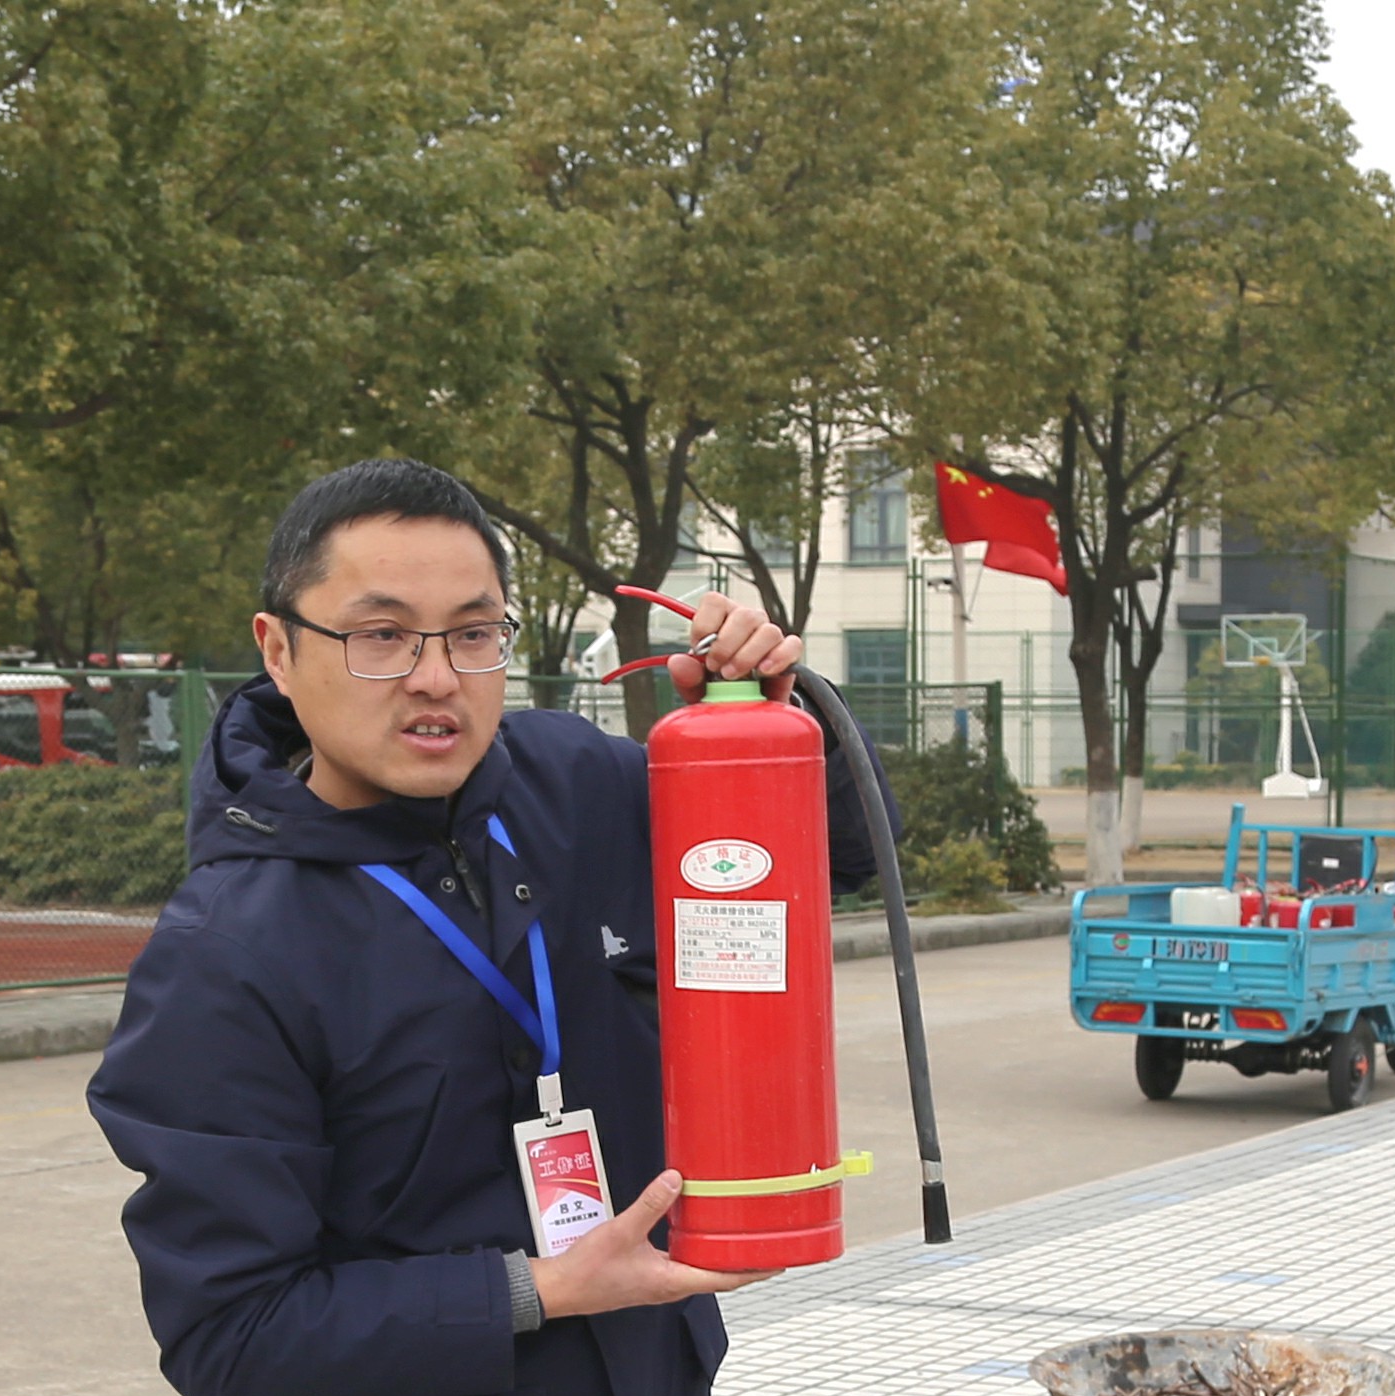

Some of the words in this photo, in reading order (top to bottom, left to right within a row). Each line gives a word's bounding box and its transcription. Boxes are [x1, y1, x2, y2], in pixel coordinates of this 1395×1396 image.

[696, 846, 753, 865] 合格证
[693, 905, 765, 916] 灭火器维修合格证
[538, 1151, 593, 1178] 工作证
